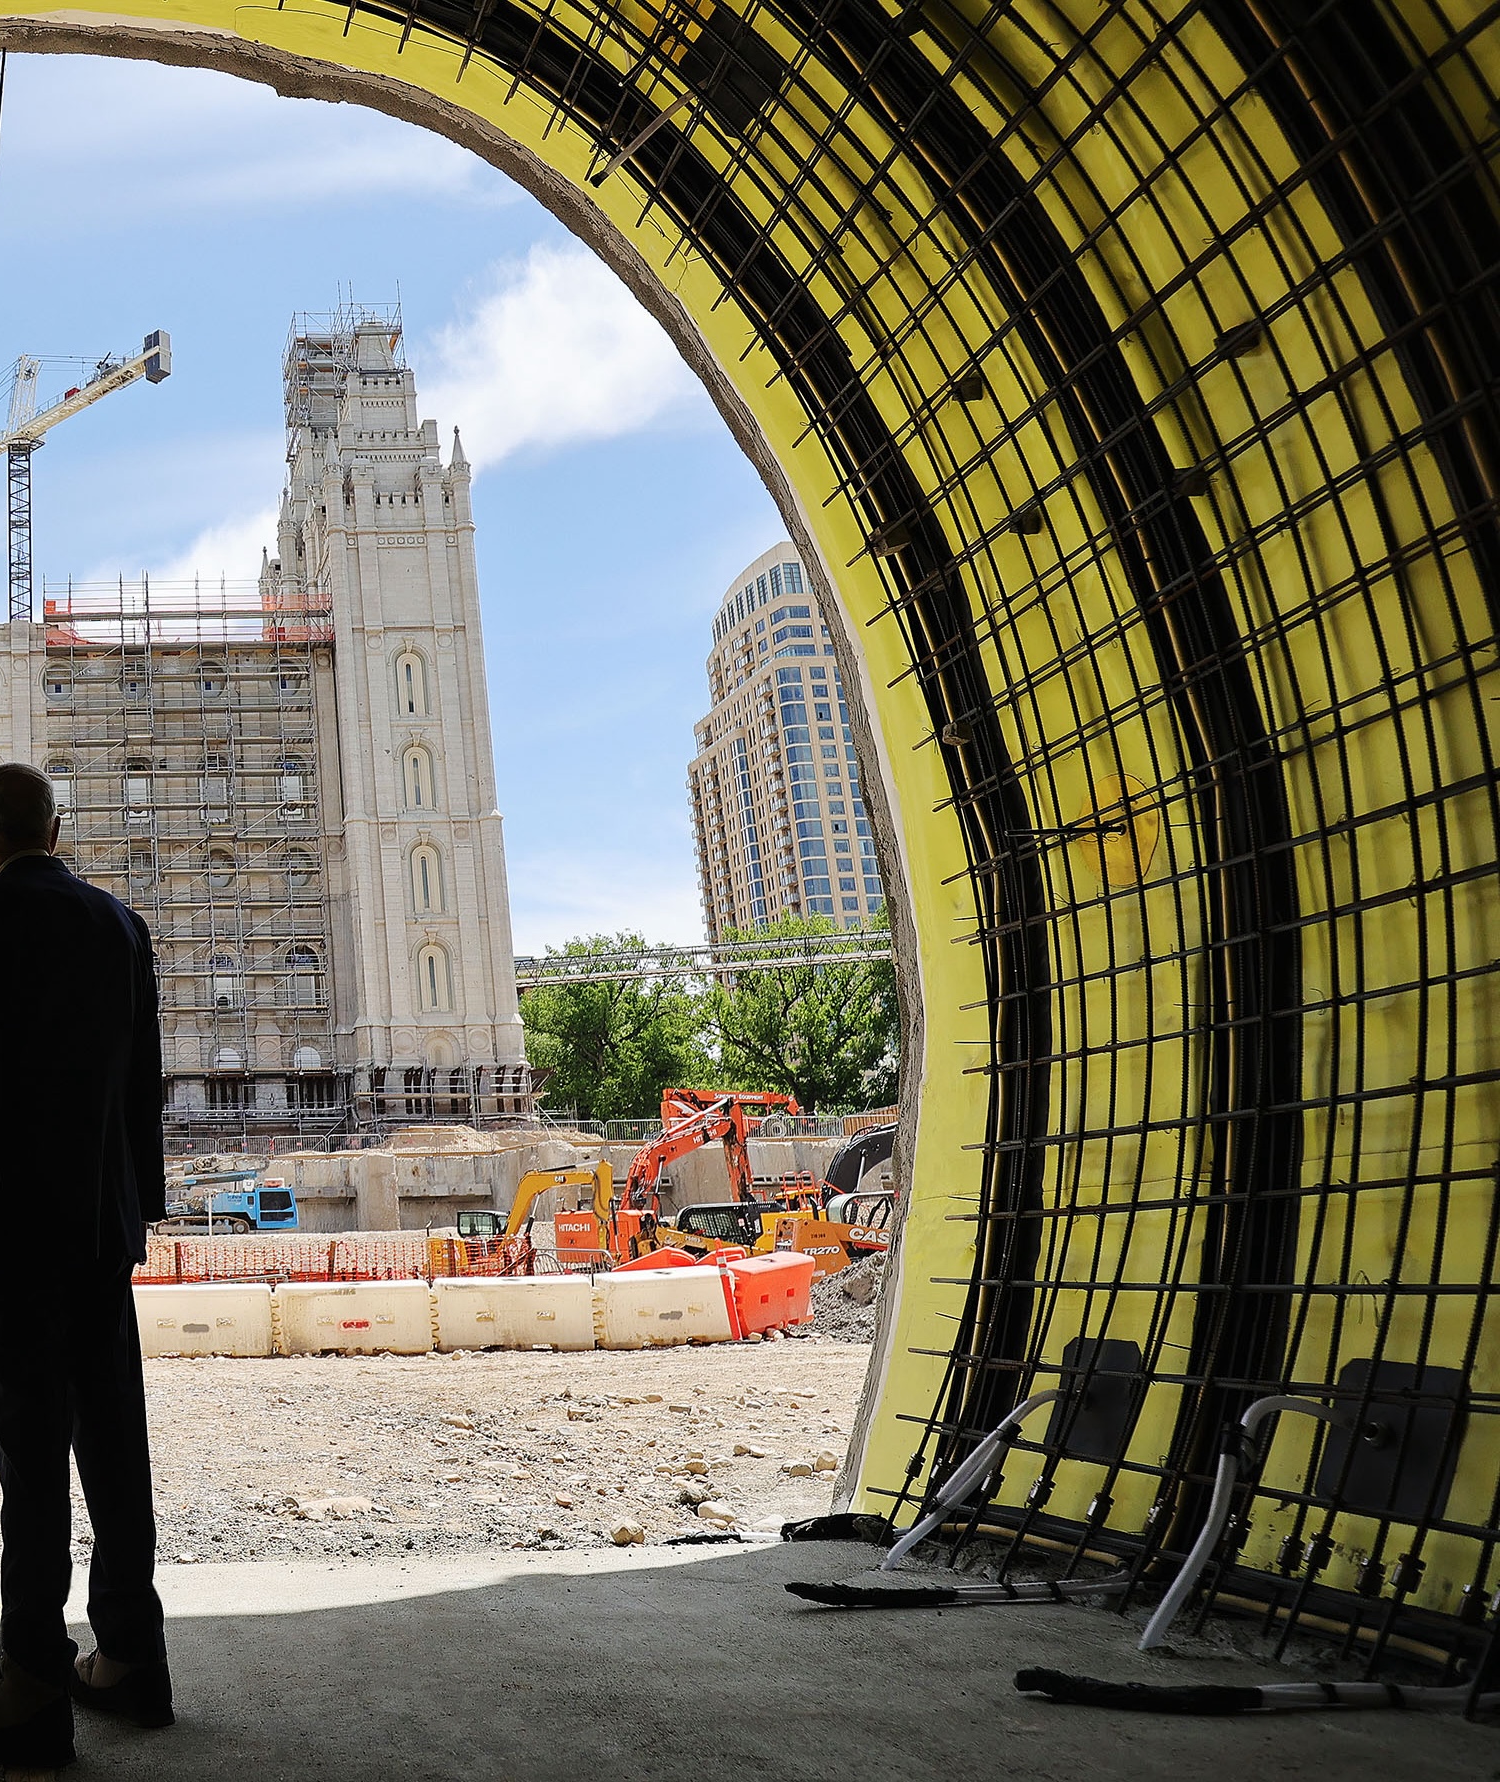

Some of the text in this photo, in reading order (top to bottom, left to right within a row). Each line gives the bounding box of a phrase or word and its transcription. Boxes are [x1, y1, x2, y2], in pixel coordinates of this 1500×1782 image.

[693, 1128, 717, 1144] HITHI
[559, 1223, 590, 1232] HITACHI
[848, 1227, 890, 1244] CAS
[802, 1245, 840, 1255] TR270
